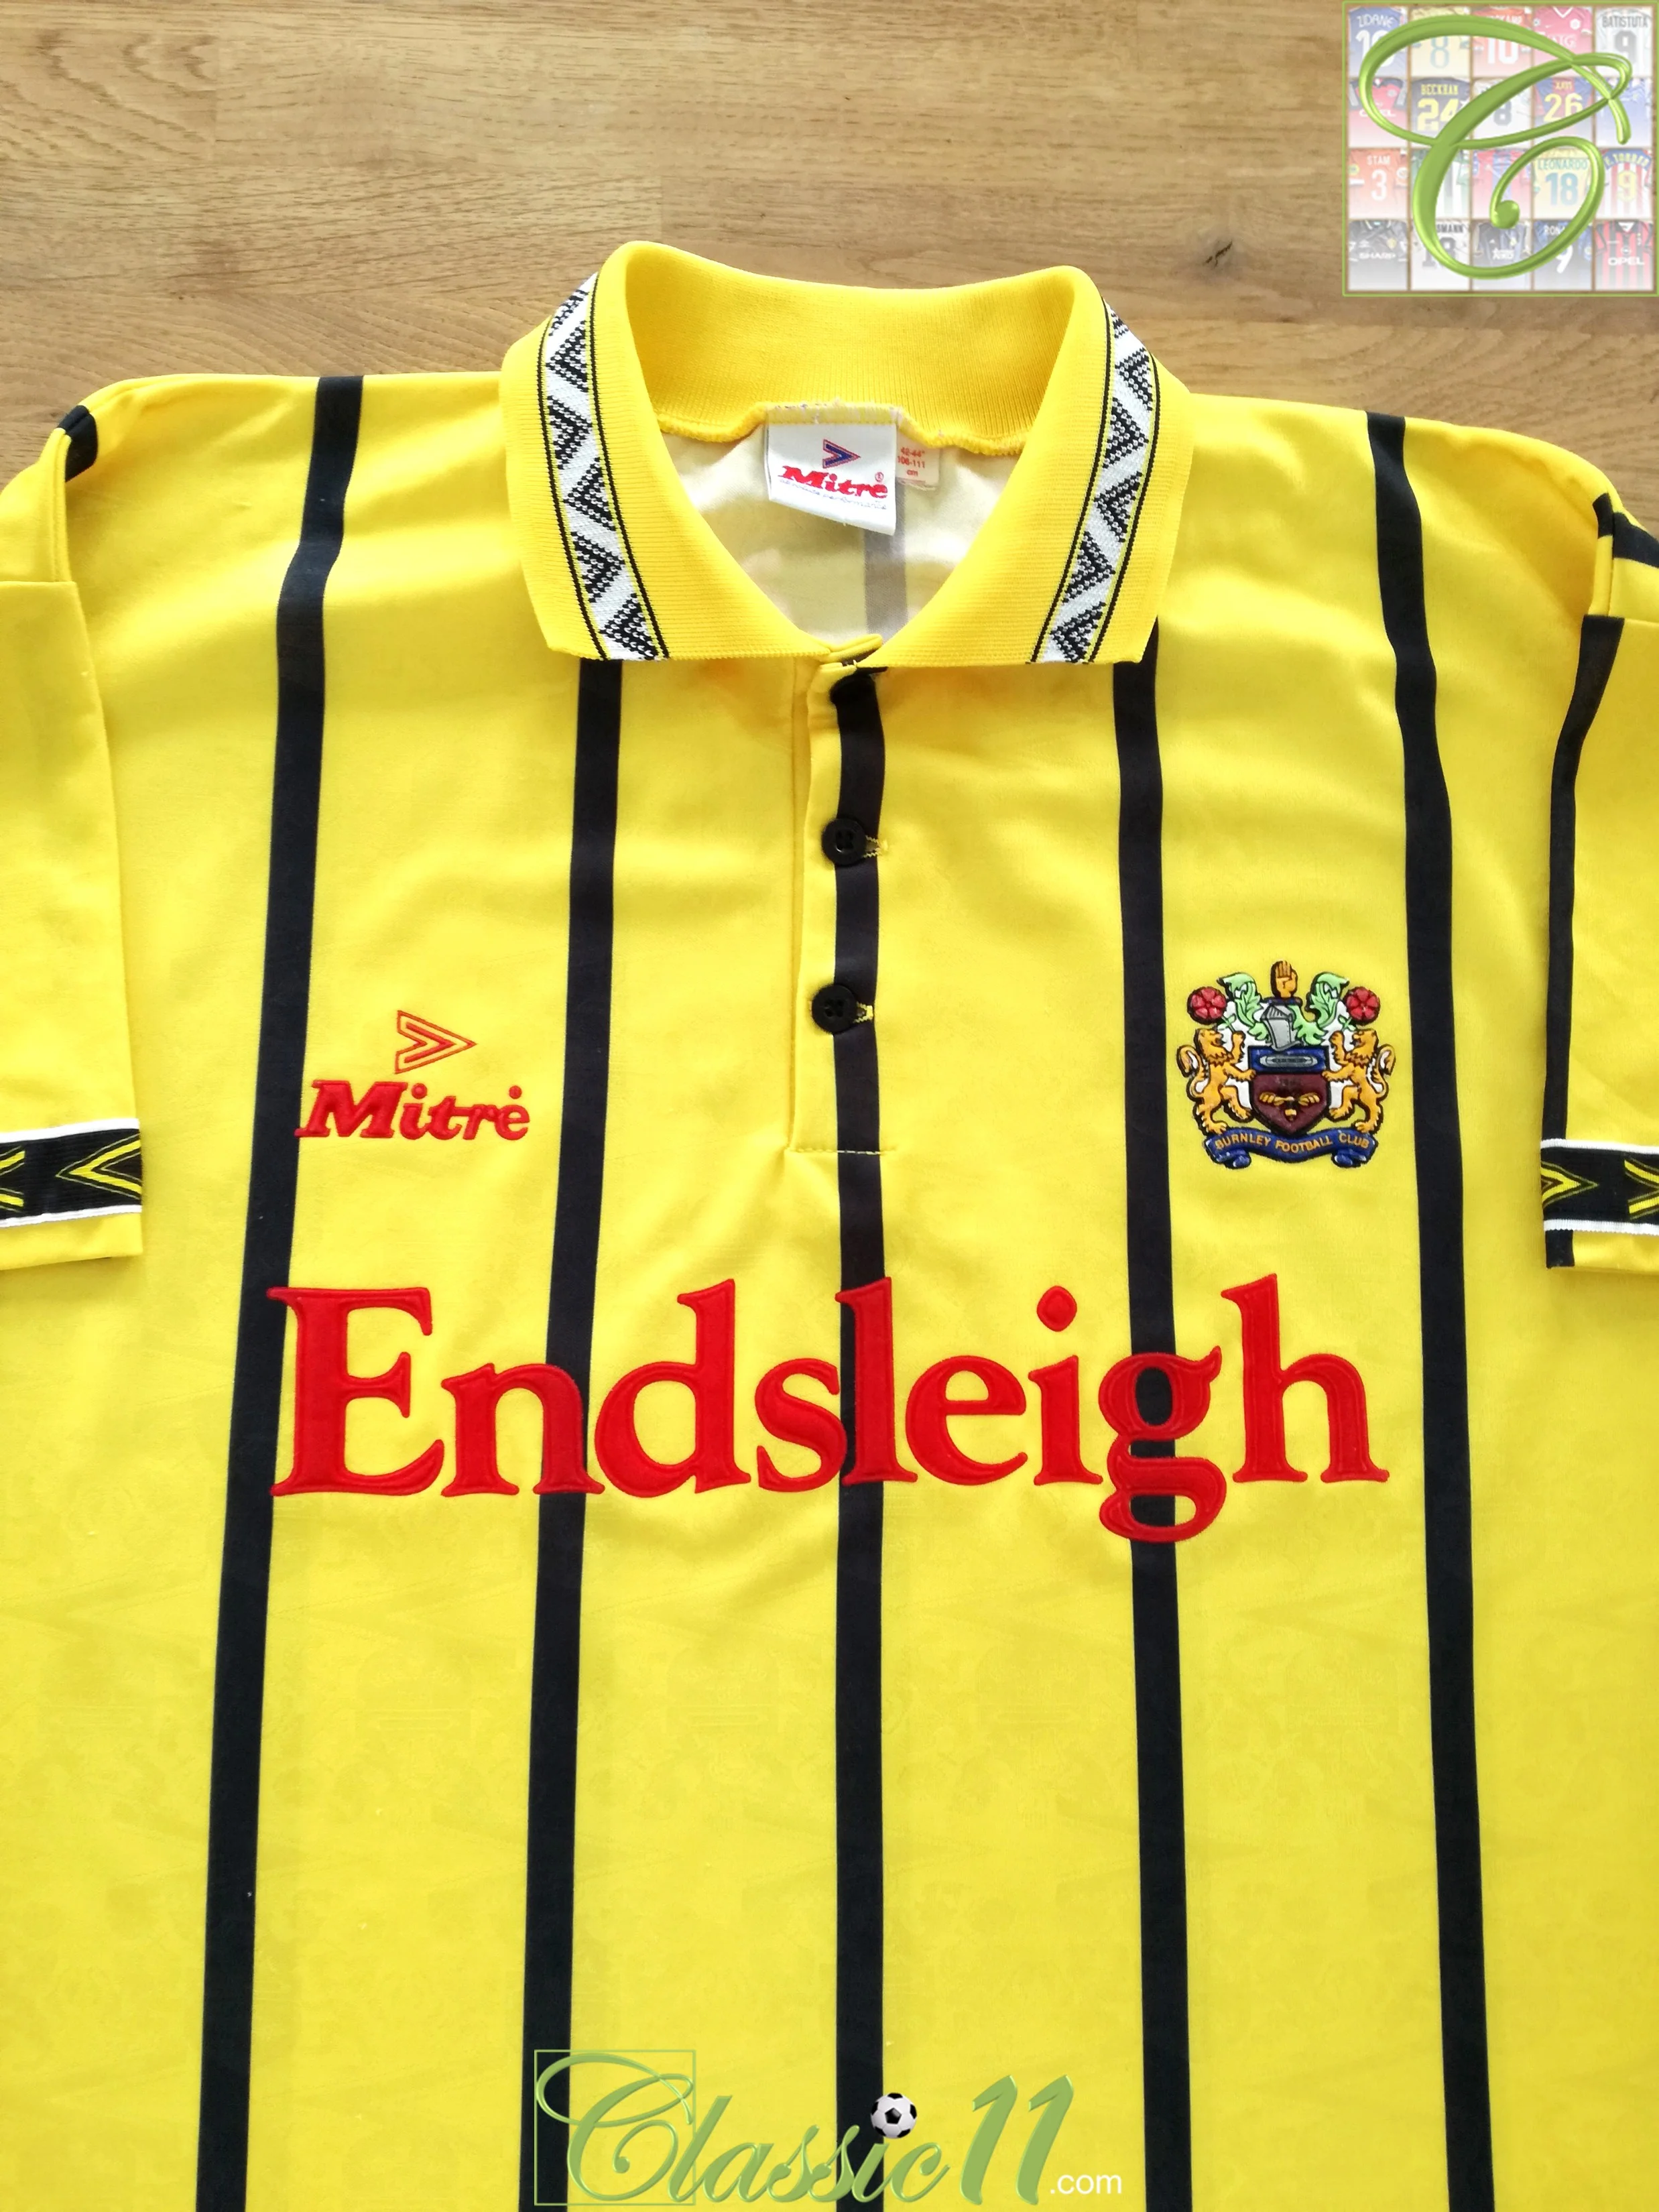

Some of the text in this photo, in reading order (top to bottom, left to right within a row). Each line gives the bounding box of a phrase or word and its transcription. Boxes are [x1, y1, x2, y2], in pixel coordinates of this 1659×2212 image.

[1215, 1133, 1370, 1154] BURNLEY FOOTBALL CLUB
[268, 1274, 1390, 1543] Endsleigh
